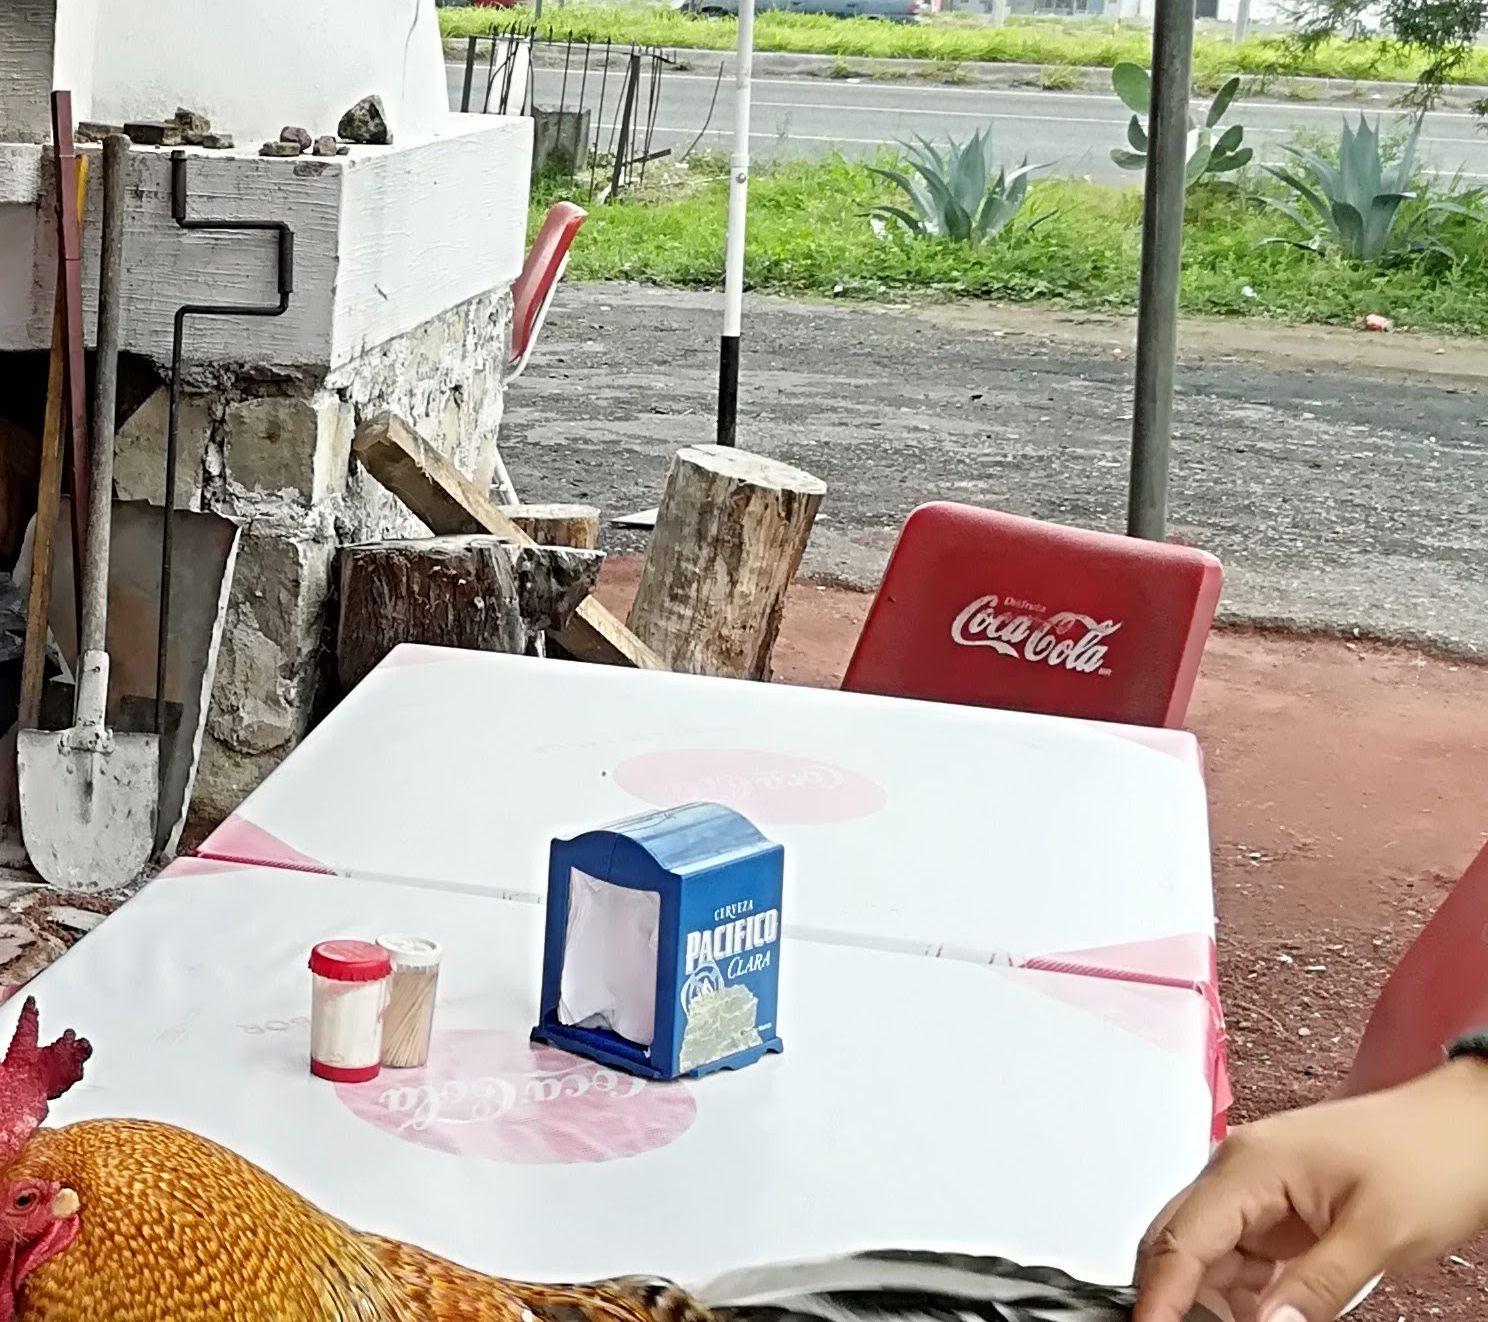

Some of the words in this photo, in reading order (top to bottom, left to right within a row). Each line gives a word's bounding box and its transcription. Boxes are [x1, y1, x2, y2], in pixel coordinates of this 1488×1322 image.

[714, 899, 754, 921] CERVEZA
[685, 908, 779, 976] PACIFICO
[727, 950, 771, 980] CLARA
